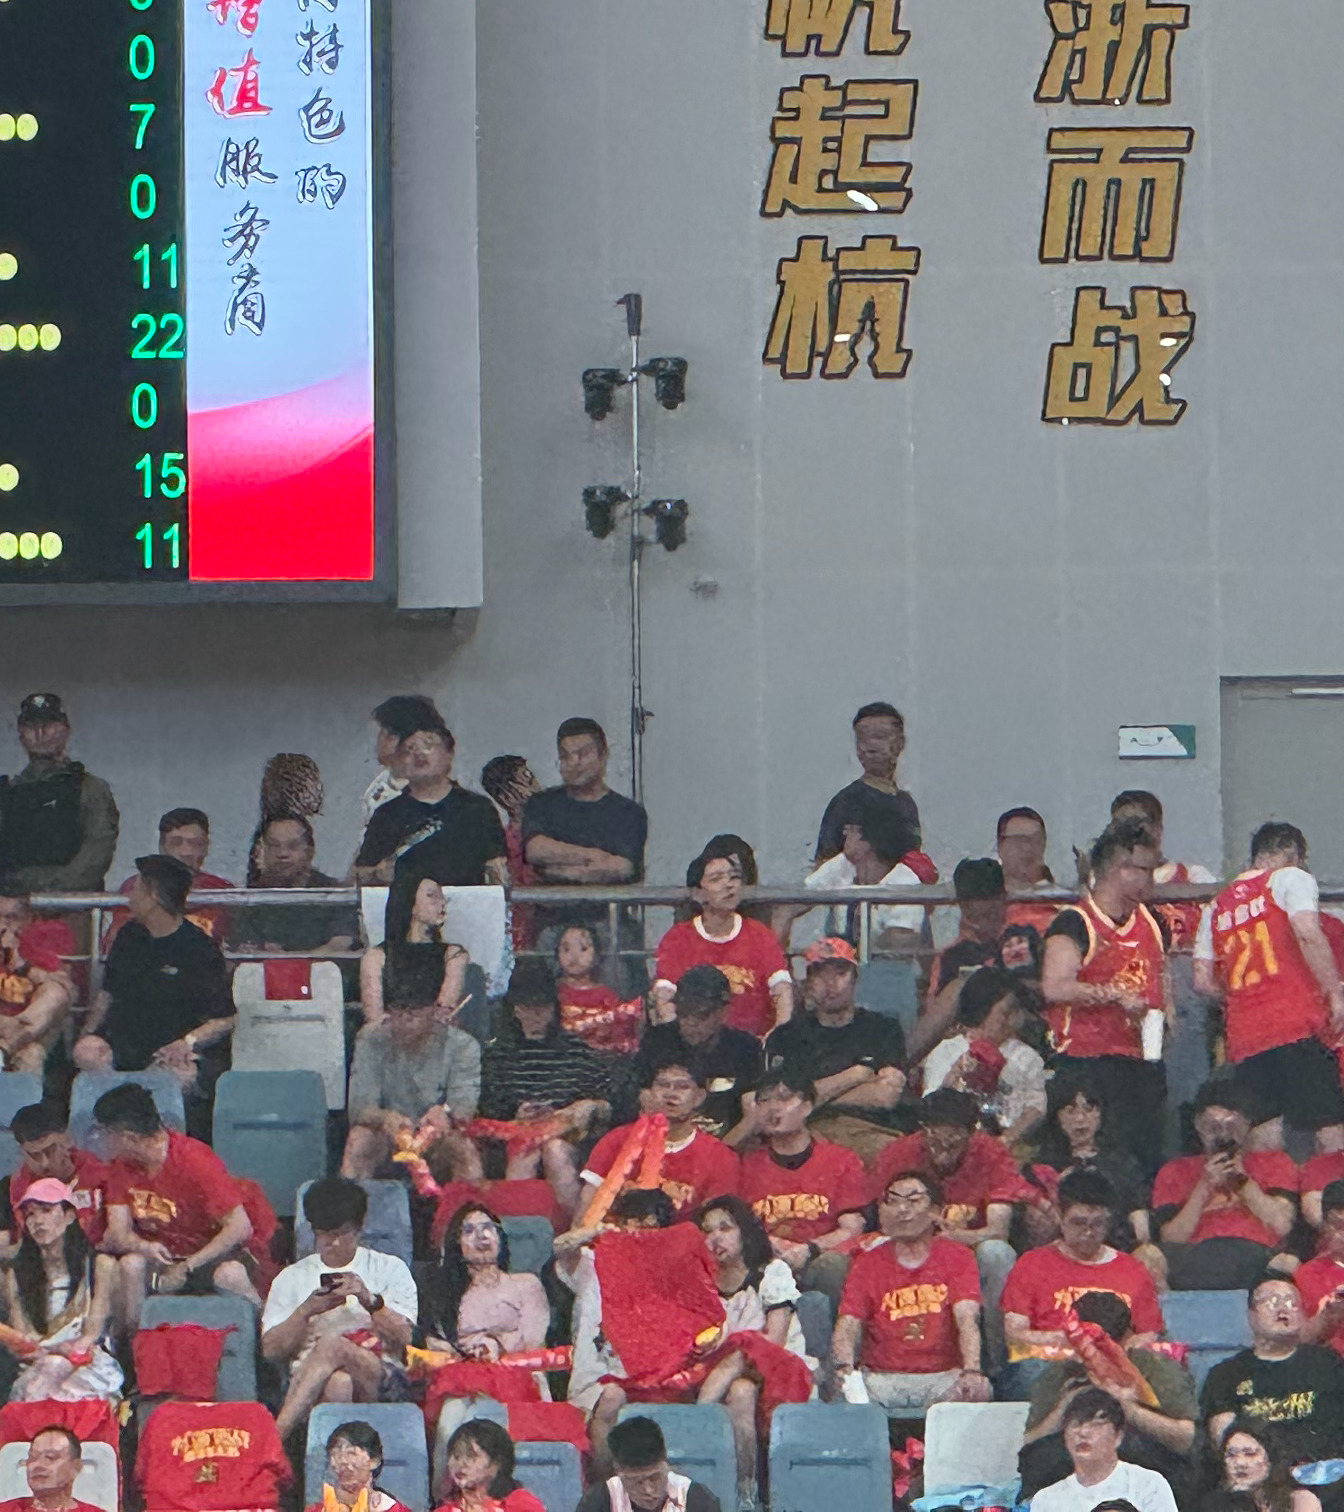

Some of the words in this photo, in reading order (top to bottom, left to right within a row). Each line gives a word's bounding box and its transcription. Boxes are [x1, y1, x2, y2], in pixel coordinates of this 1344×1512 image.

[130, 35, 154, 80] 0
[130, 104, 155, 149] 7
[130, 174, 156, 219] 0
[134, 243, 177, 289] 11
[131, 313, 183, 359] 22
[132, 383, 157, 429] 0
[136, 453, 186, 498] 15
[136, 523, 179, 568] 11
